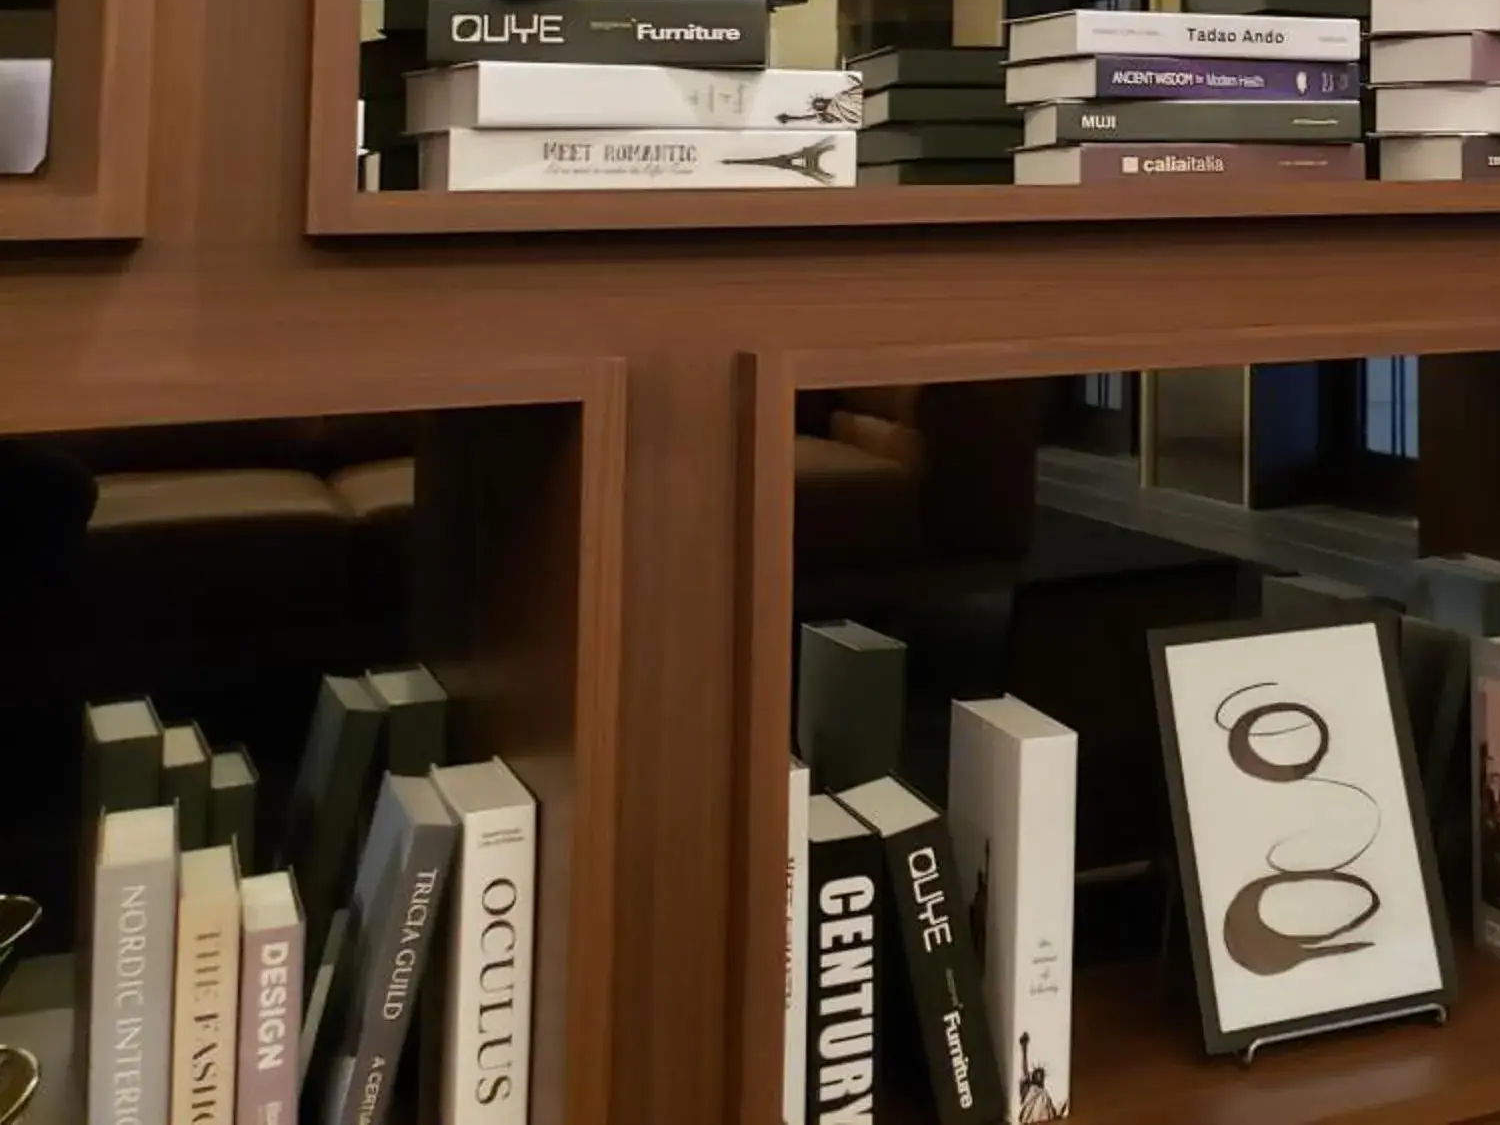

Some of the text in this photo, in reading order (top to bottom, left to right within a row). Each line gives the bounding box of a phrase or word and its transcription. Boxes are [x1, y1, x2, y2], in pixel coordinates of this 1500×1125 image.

[636, 23, 741, 42] Furniture
[1186, 27, 1285, 44] Tadao Ando
[1111, 70, 1154, 85] ANCIENT
[1154, 72, 1194, 86] WISDOM
[542, 140, 698, 163] MEET ROMANTIC
[1081, 114, 1116, 130] MUJI
[113, 883, 149, 1009] NORDIC
[192, 930, 222, 1004] THE
[383, 867, 439, 1021] TRICIA GUILD
[256, 940, 290, 1072] DESIGN
[475, 877, 517, 1106] OCULUS
[818, 874, 875, 1125] CENTURY
[942, 1010, 974, 1110] Furniture
